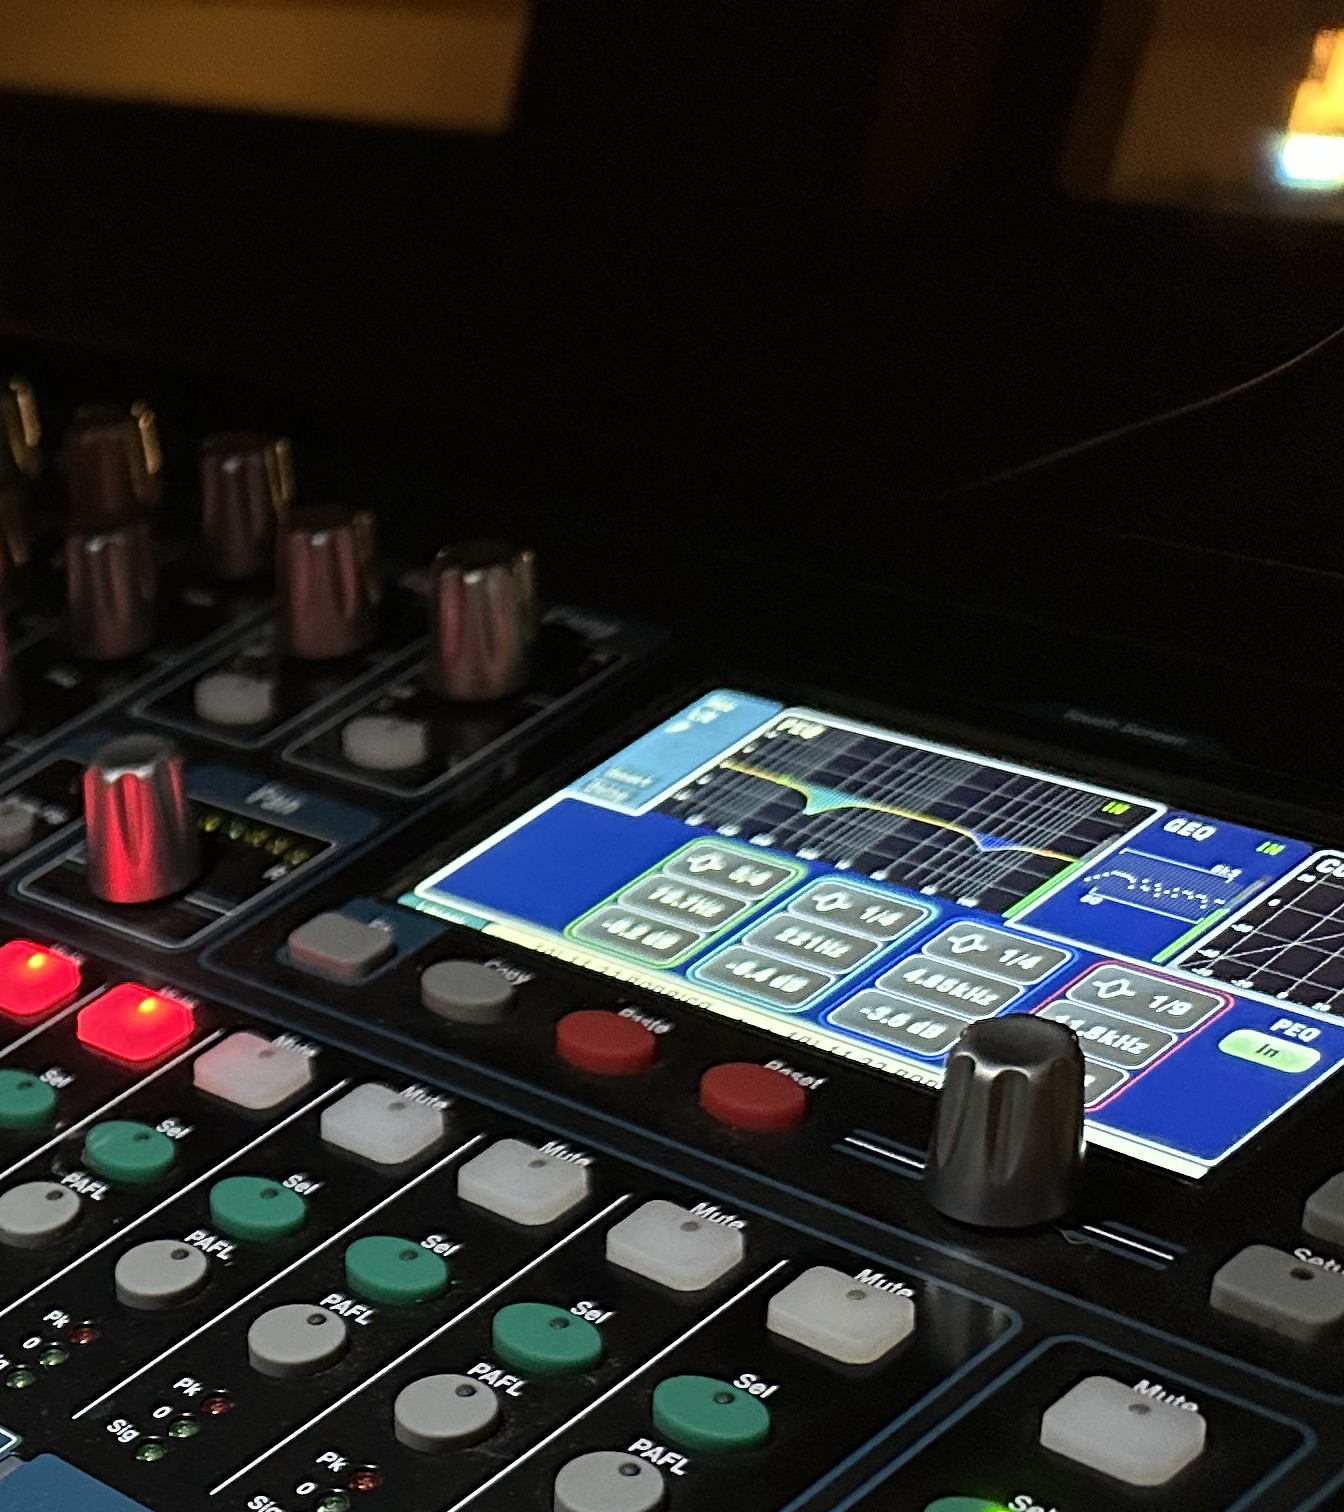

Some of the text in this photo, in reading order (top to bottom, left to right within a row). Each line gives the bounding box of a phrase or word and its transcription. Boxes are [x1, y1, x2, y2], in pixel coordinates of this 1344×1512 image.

[1164, 818, 1217, 842] GEQ
[998, 949, 1044, 970] 1/4
[1148, 995, 1193, 1016] 1/9
[1270, 1018, 1321, 1042] PEQ
[61, 1170, 112, 1201] PAFL
[688, 1202, 746, 1232] Mute
[185, 1228, 234, 1262] PAFL
[420, 1234, 462, 1258] Sel
[854, 1268, 914, 1301] Mute
[321, 1293, 376, 1326] PAFL
[571, 1301, 614, 1325] Sel
[173, 1377, 202, 1398] Pk
[468, 1362, 526, 1397] PAFL
[734, 1373, 778, 1399] Sel
[1133, 1380, 1200, 1414] Mute
[152, 1405, 171, 1420] 0
[106, 1417, 139, 1444] Sig
[316, 1450, 348, 1474] Pk
[628, 1437, 691, 1476] PAFL
[296, 1481, 315, 1496] 0
